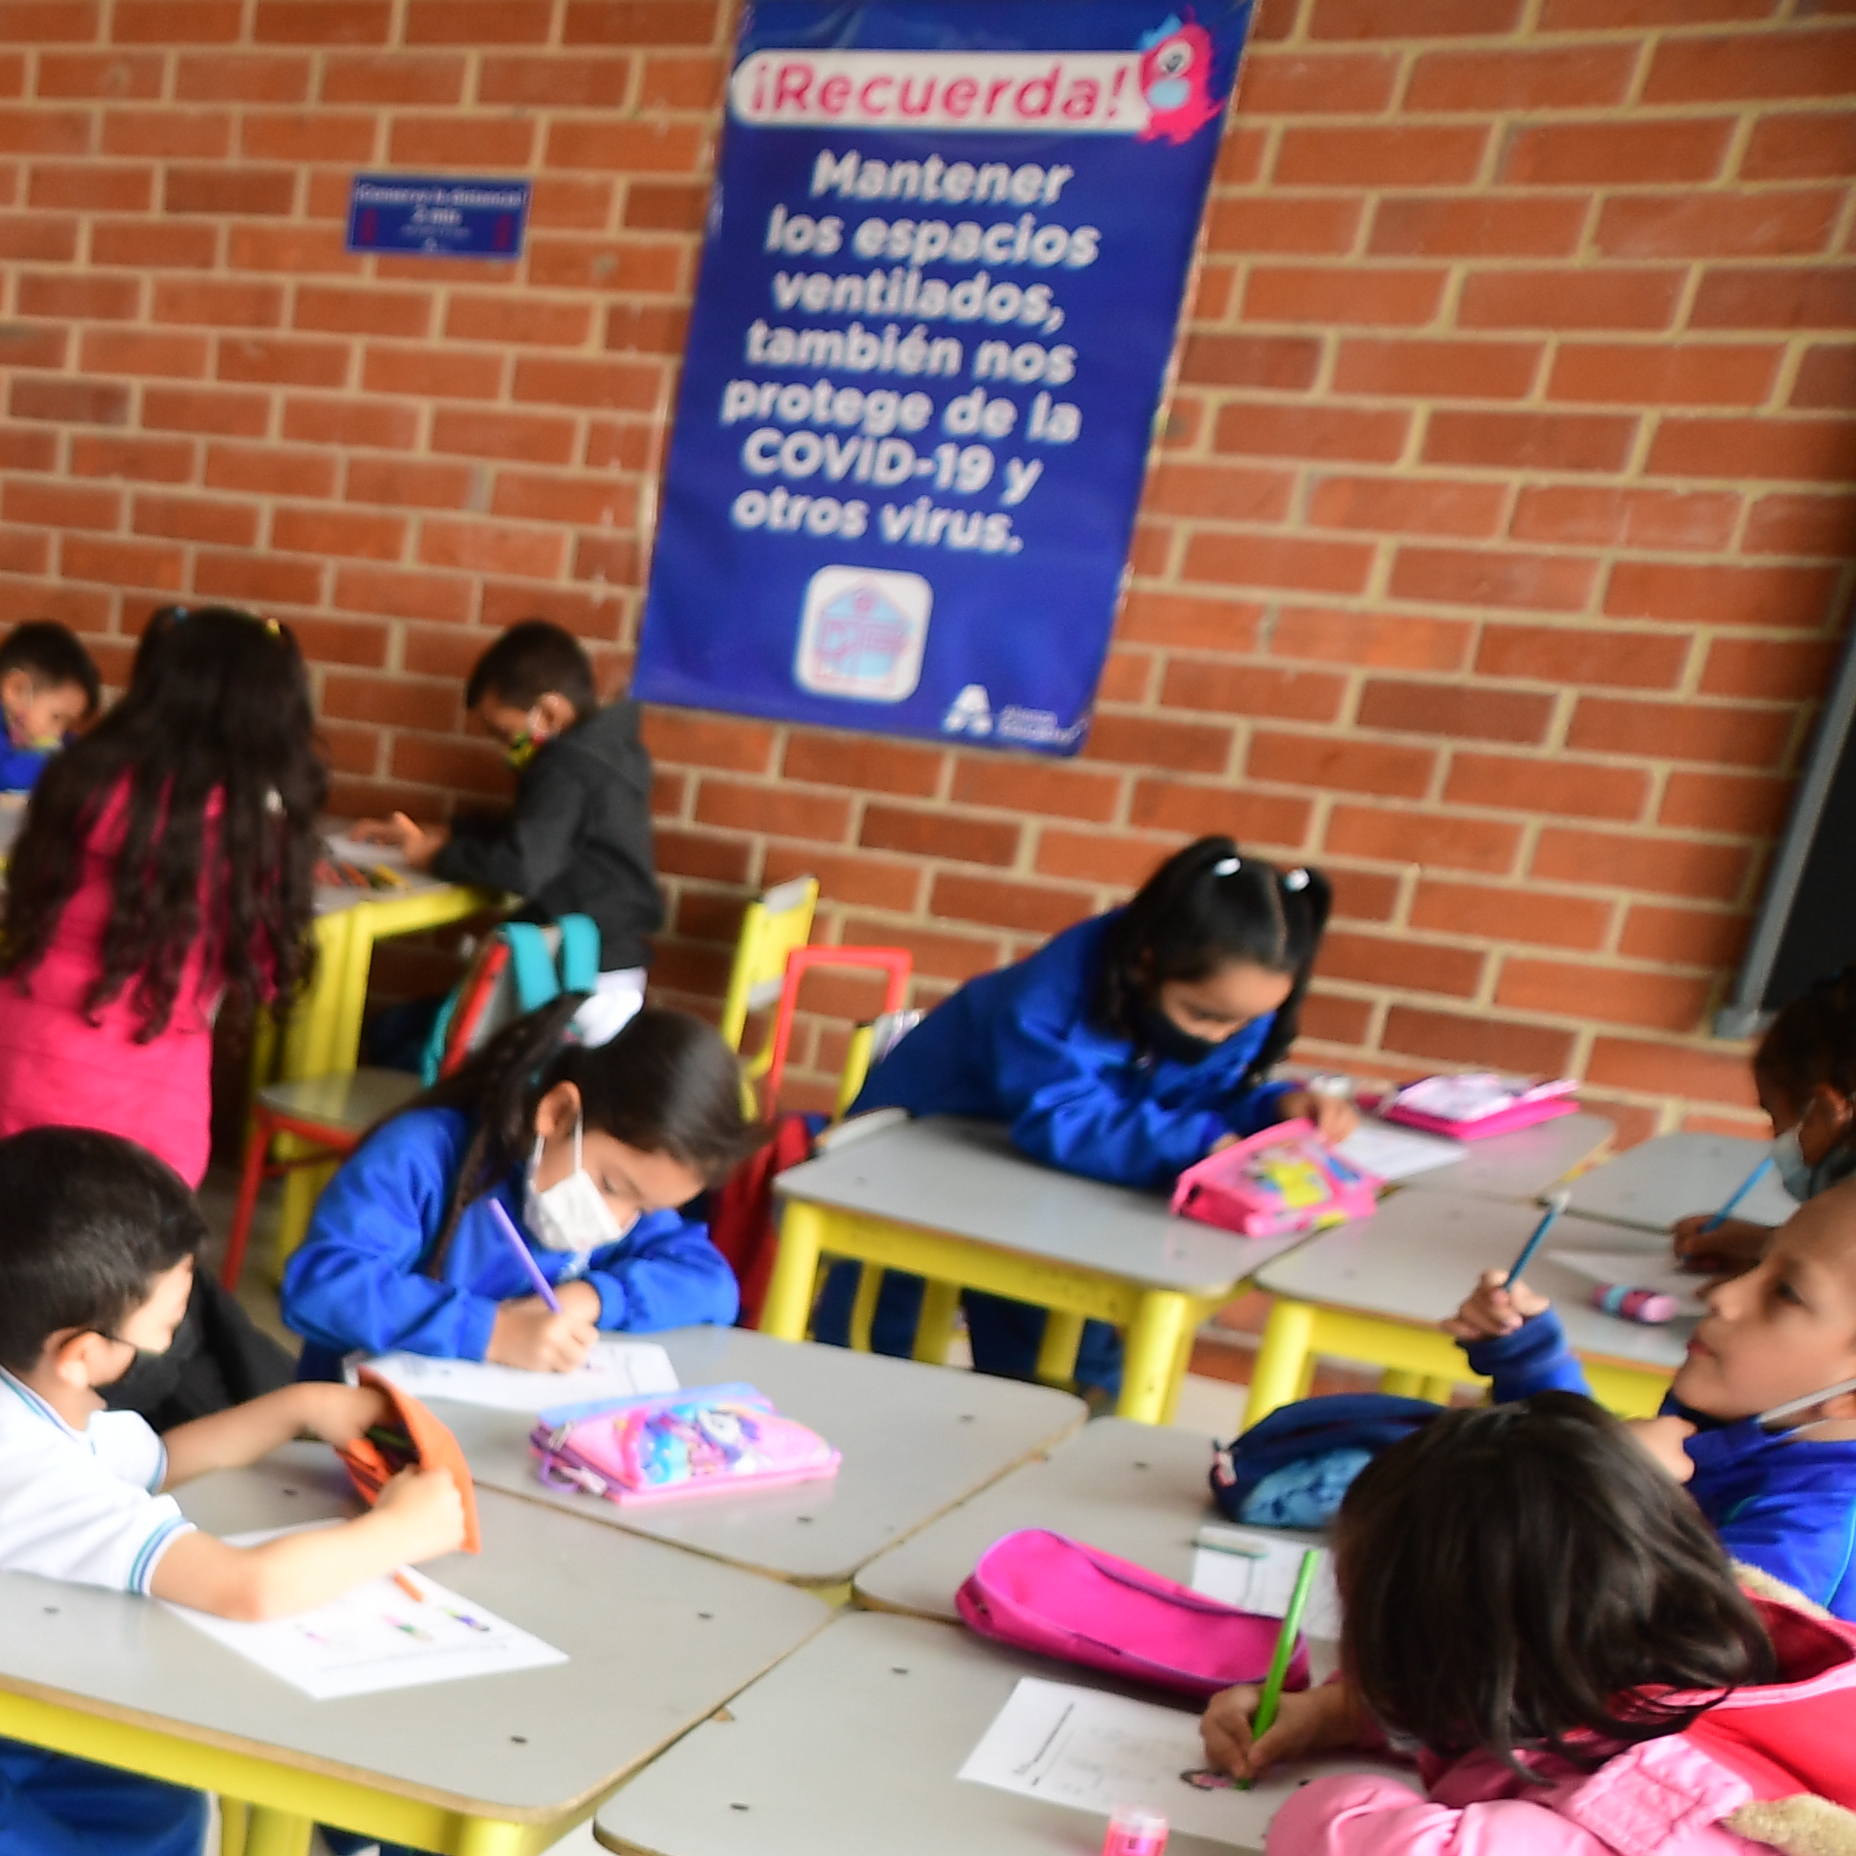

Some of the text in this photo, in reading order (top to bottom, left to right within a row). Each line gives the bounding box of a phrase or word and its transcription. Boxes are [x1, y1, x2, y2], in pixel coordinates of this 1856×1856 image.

[751, 58, 1130, 123] ¡Recuerda!
[809, 148, 1075, 205] Mantener
[766, 204, 1100, 267] los espacios
[774, 264, 1065, 333] ventilados,
[746, 319, 1078, 386] también nos
[720, 379, 1083, 444] protege de la
[742, 429, 1044, 506] COVID-19 y
[732, 486, 1025, 555] otros virus.
